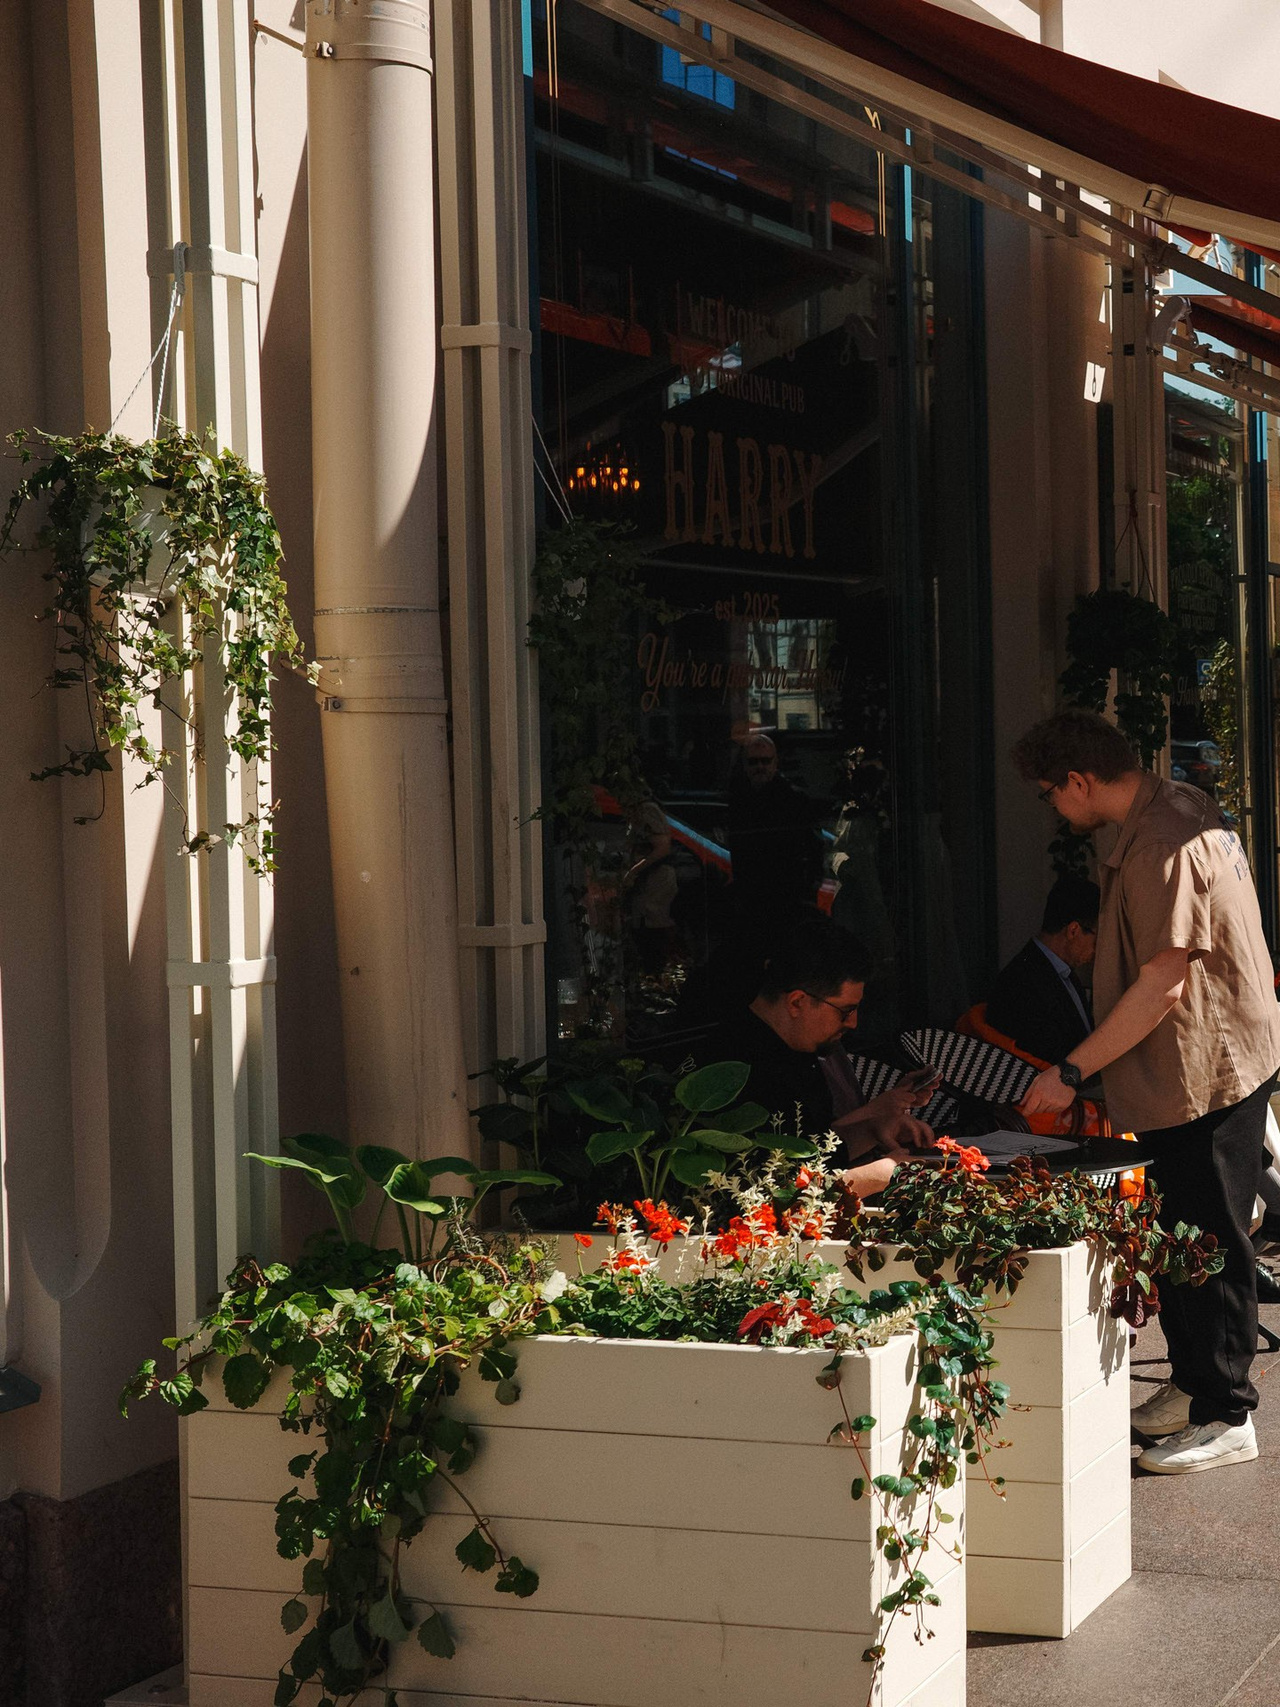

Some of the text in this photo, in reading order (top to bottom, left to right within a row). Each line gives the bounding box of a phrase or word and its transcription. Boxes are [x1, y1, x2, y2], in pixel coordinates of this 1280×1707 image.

[718, 371, 780, 408] ORIGINAL
[780, 382, 806, 414] PUB
[661, 420, 824, 560] HARRY
[743, 591, 780, 624] 2025
[637, 632, 707, 713] You're
[711, 663, 722, 689] a
